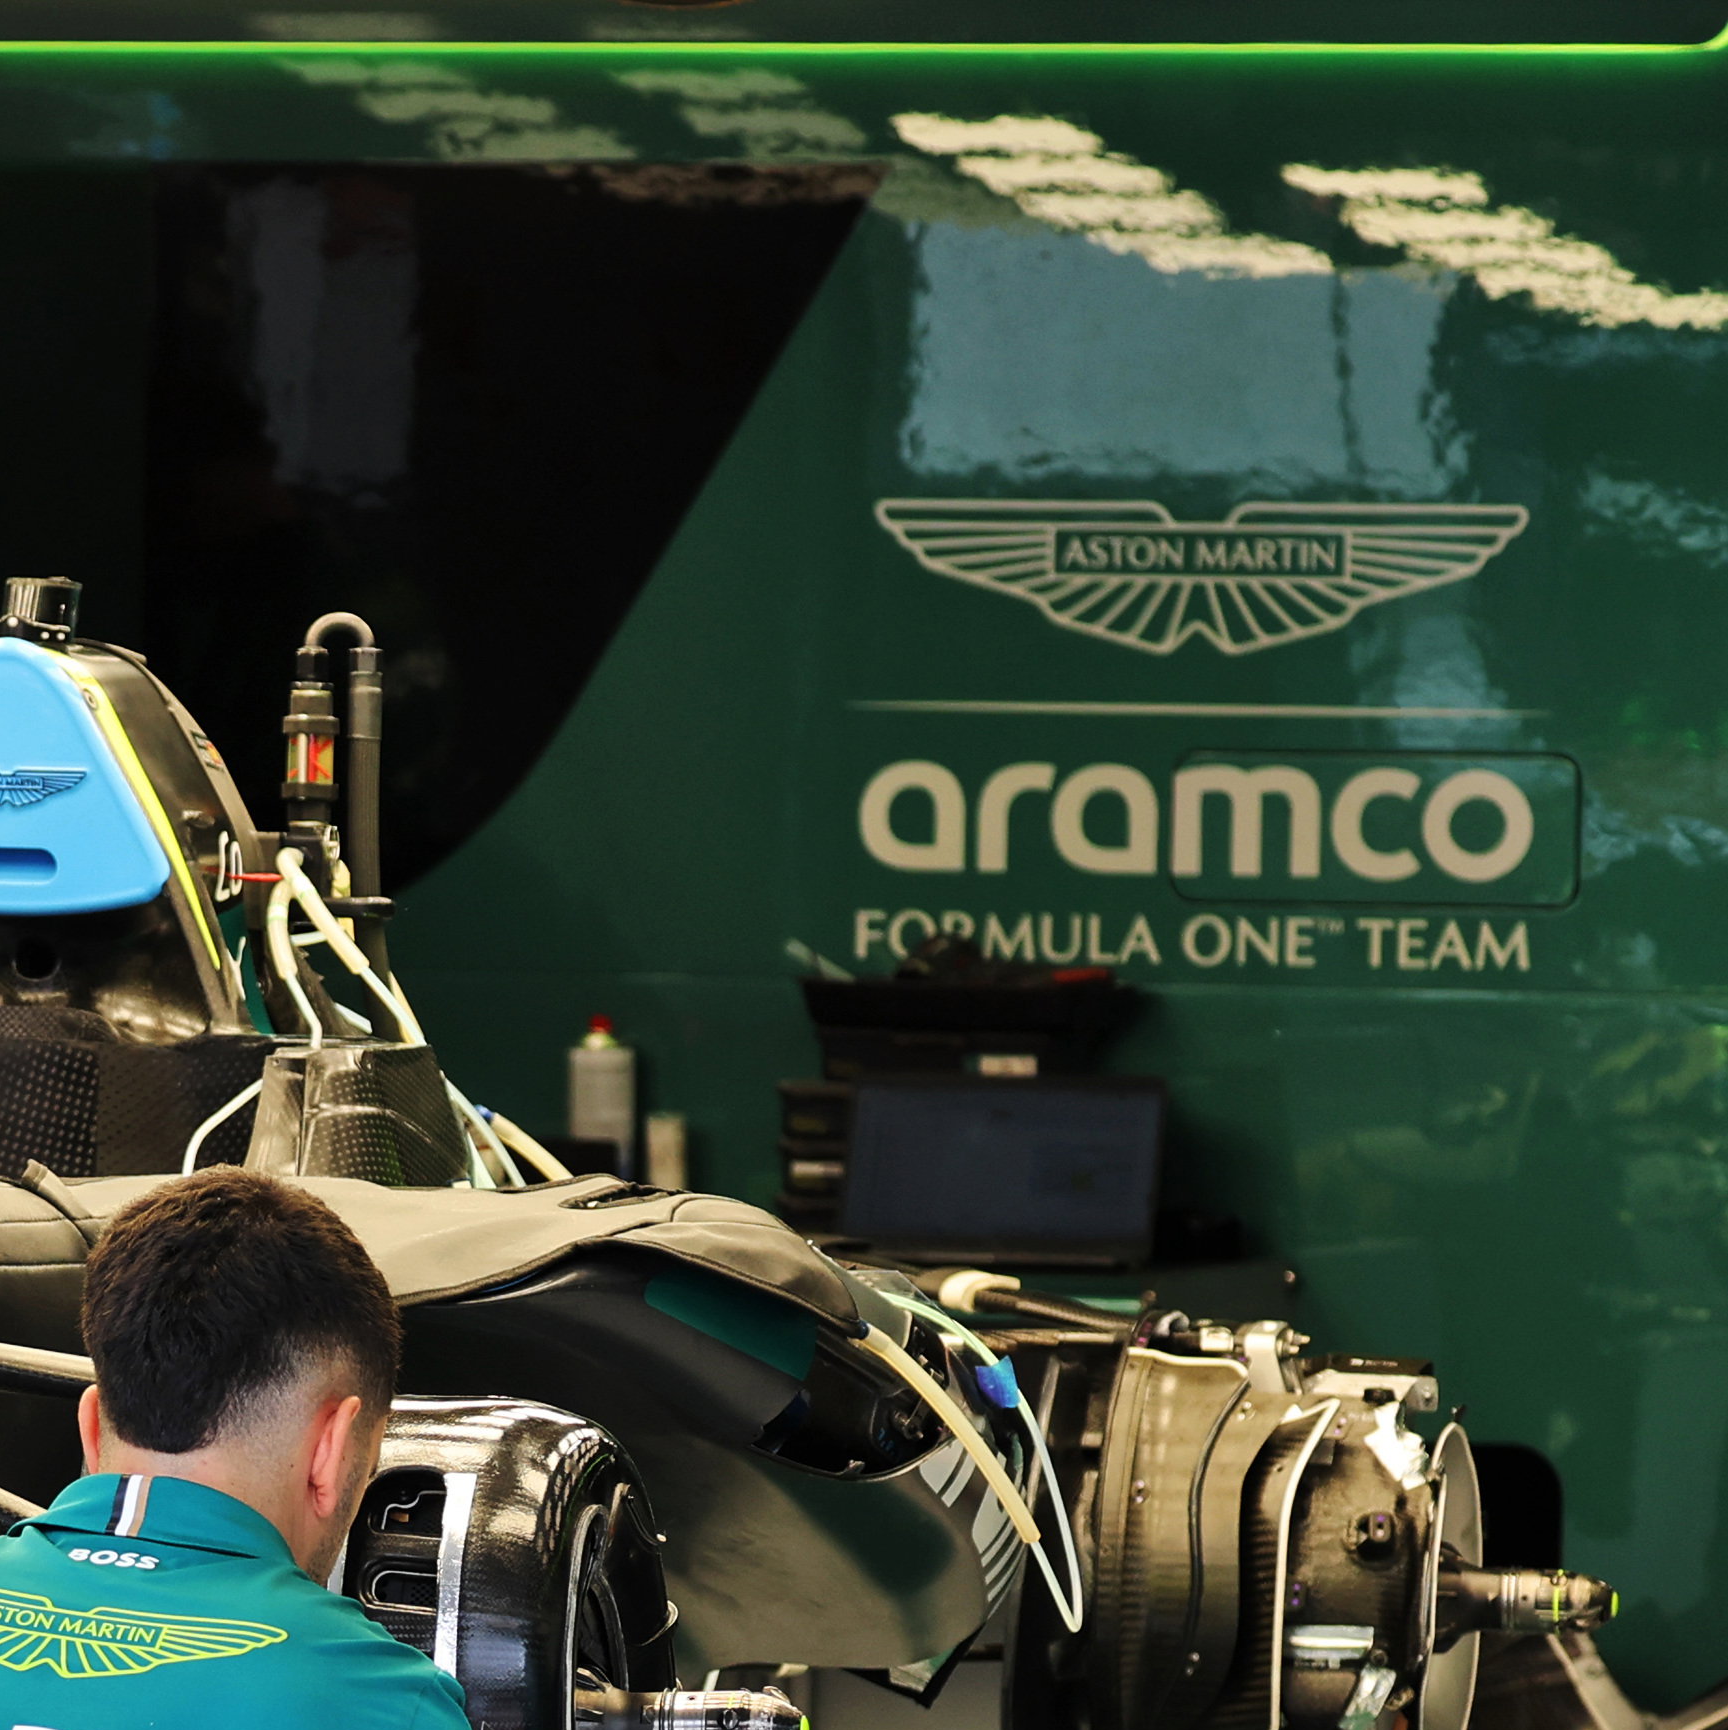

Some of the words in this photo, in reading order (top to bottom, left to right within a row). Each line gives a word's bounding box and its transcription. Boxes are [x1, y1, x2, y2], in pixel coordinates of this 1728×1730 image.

[1063, 536, 1185, 570] ASTON
[1195, 539, 1337, 572] MARTIN
[858, 759, 1535, 884] aramco
[1357, 917, 1529, 971] TEAM
[68, 1548, 159, 1570] BOSS
[58, 1617, 156, 1643] MARTIN
